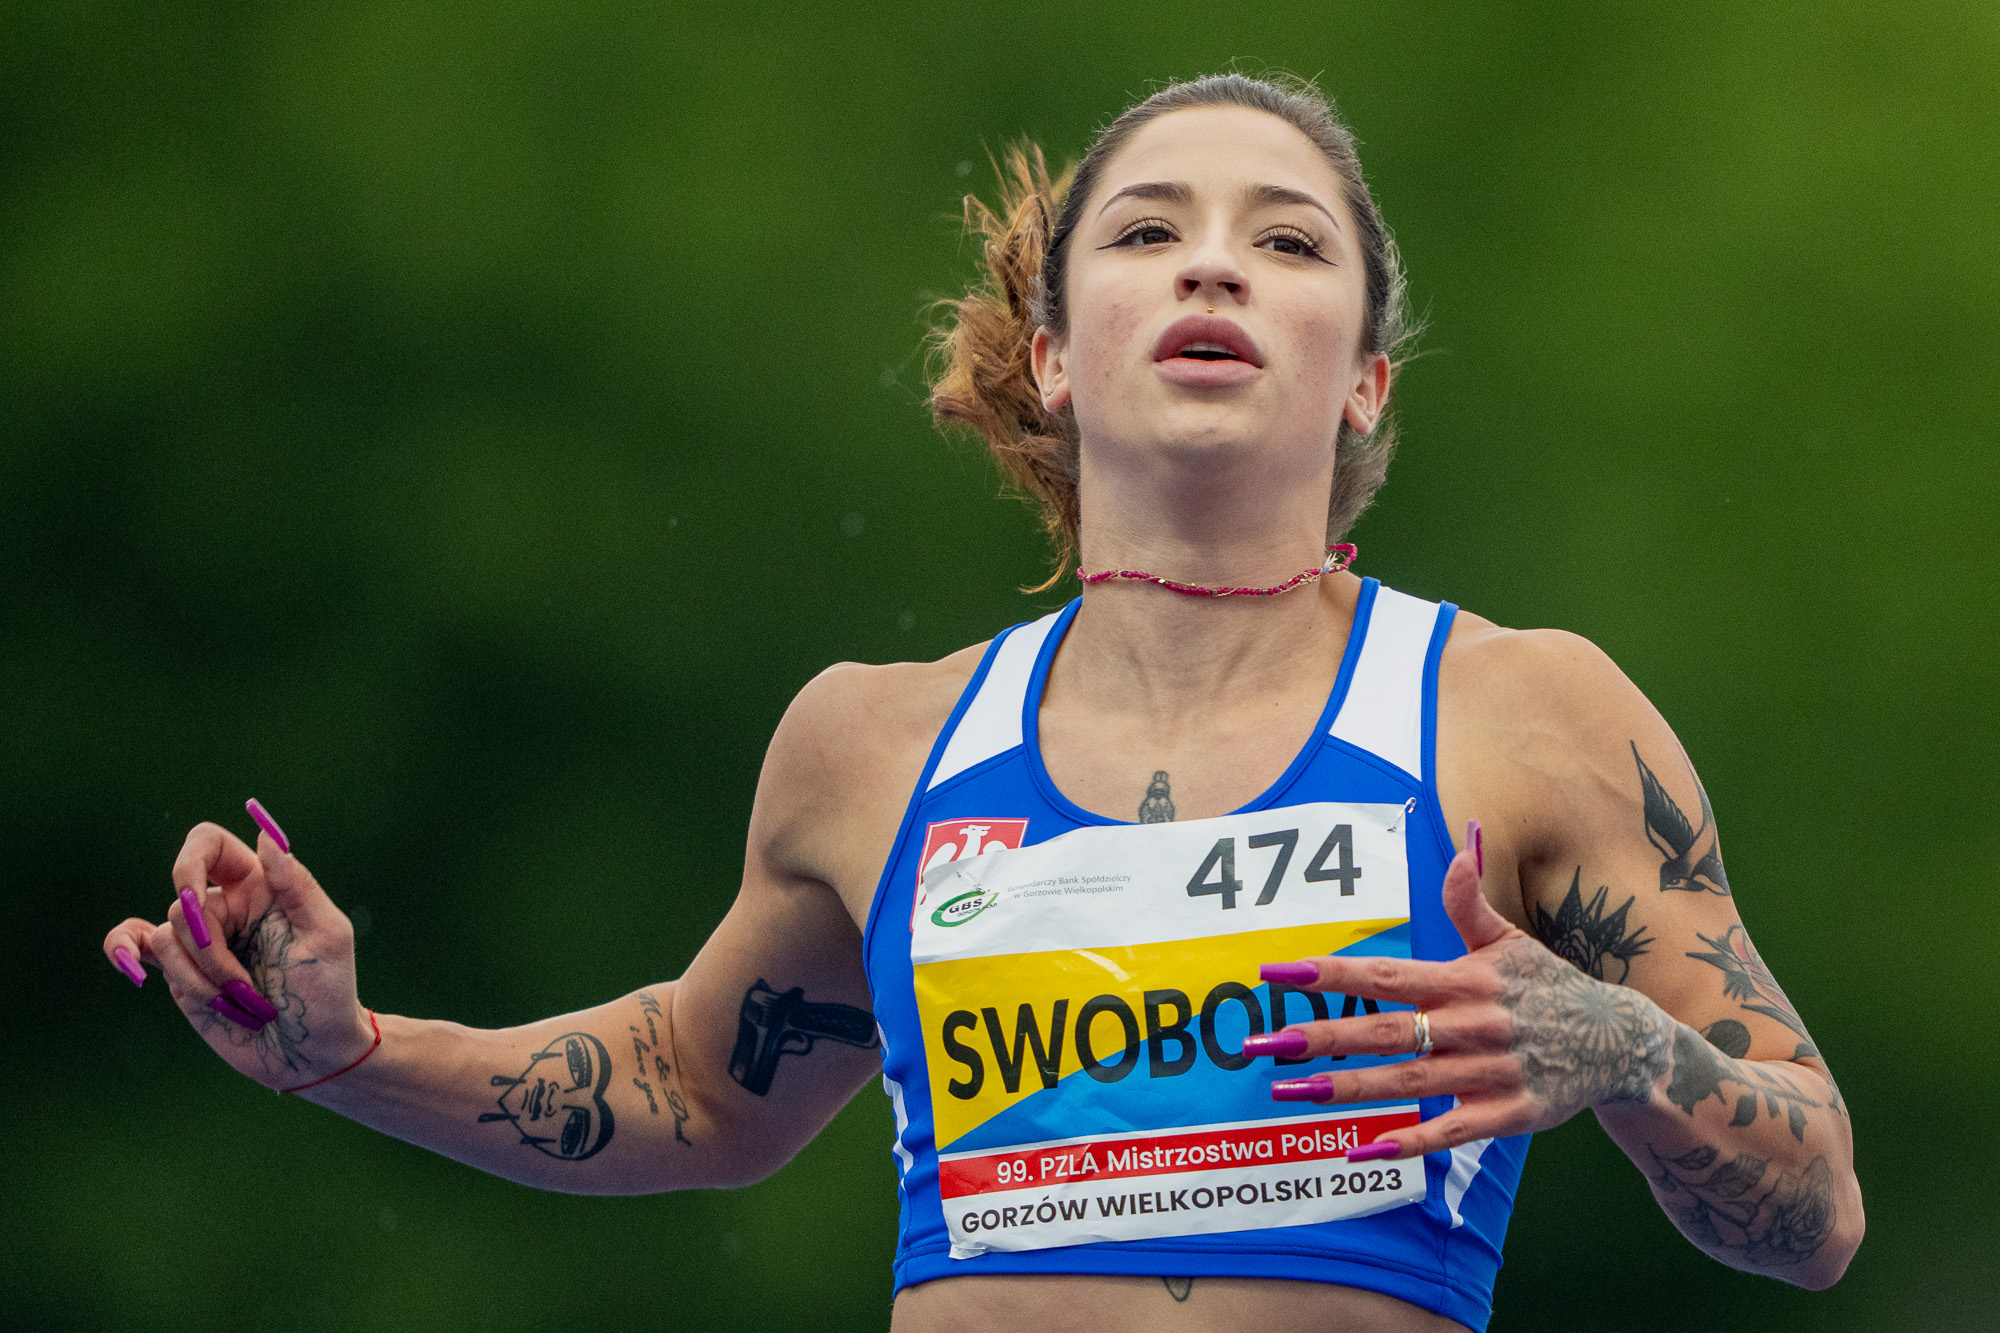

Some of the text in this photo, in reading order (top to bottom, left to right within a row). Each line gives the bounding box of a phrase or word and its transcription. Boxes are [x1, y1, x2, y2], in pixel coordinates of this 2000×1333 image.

[1058, 876, 1079, 885] Bank
[1081, 874, 1132, 885] Spółdzielczy
[1186, 823, 1362, 910] 474
[949, 898, 983, 913] GBS
[1023, 889, 1062, 898] Gorzowie
[1064, 884, 1124, 895] Wielkopolskim
[635, 990, 662, 1047] Mom
[655, 1055, 670, 1083] &
[633, 1077, 659, 1115] you
[997, 1125, 1360, 1184] 99. PZLA Mistrzostwa Polski
[961, 1168, 1403, 1233] GORZÓW WIELKOPOLSKI 2023
